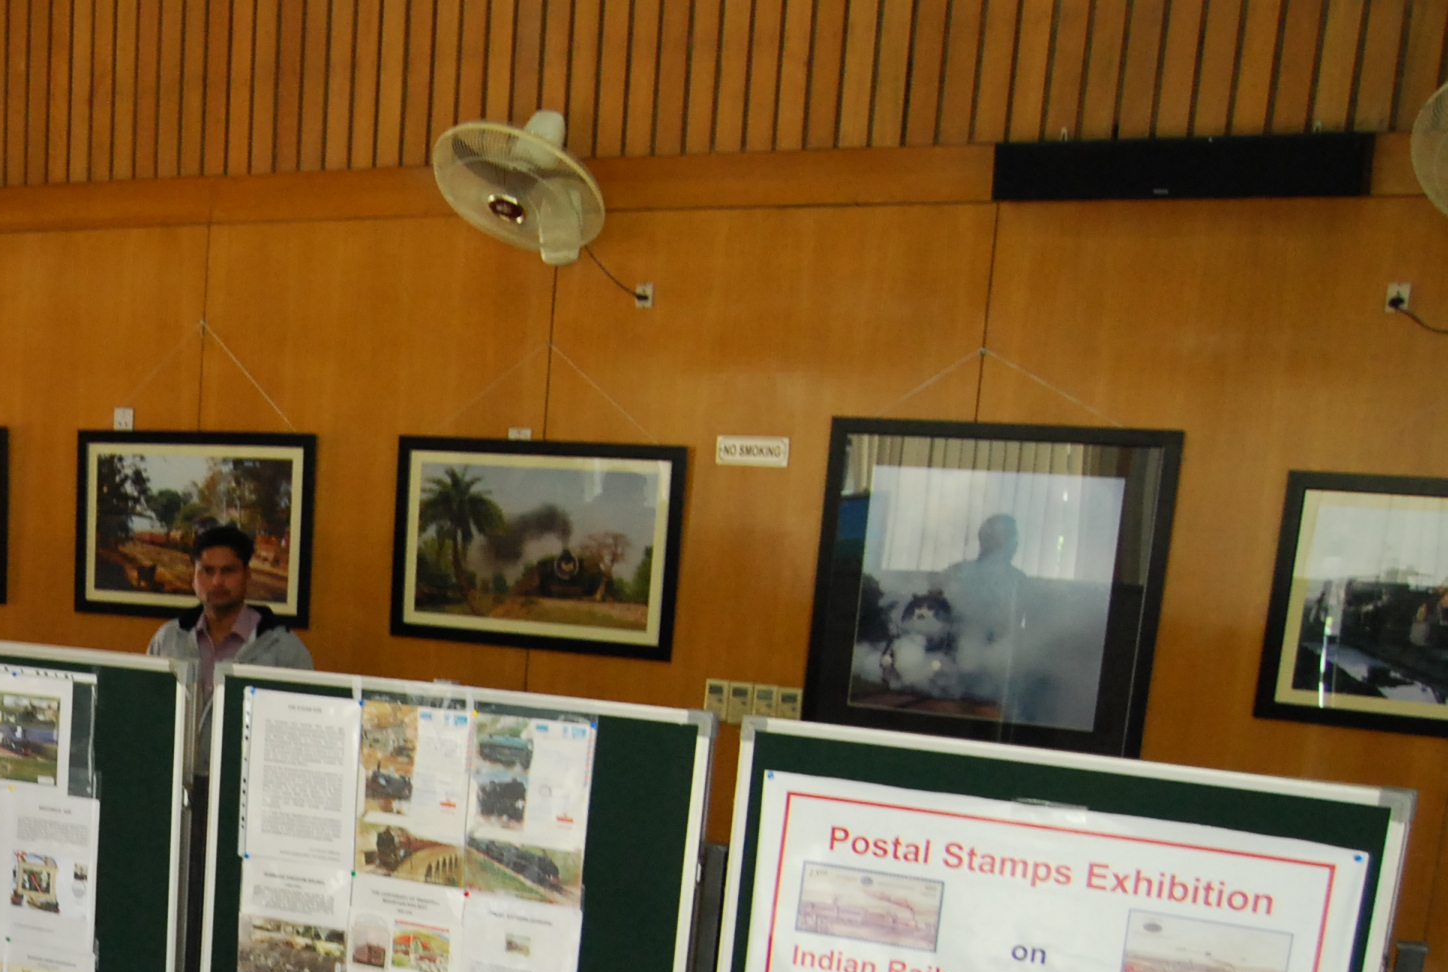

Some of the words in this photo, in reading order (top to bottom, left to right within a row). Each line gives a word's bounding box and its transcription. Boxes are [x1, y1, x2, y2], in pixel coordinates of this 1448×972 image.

[723, 444, 737, 456] NO
[739, 444, 781, 457] SMOKING
[829, 825, 933, 864] Postal
[943, 842, 1073, 887] Stamps
[1086, 862, 1277, 915] Exhibition
[1011, 943, 1048, 966] on
